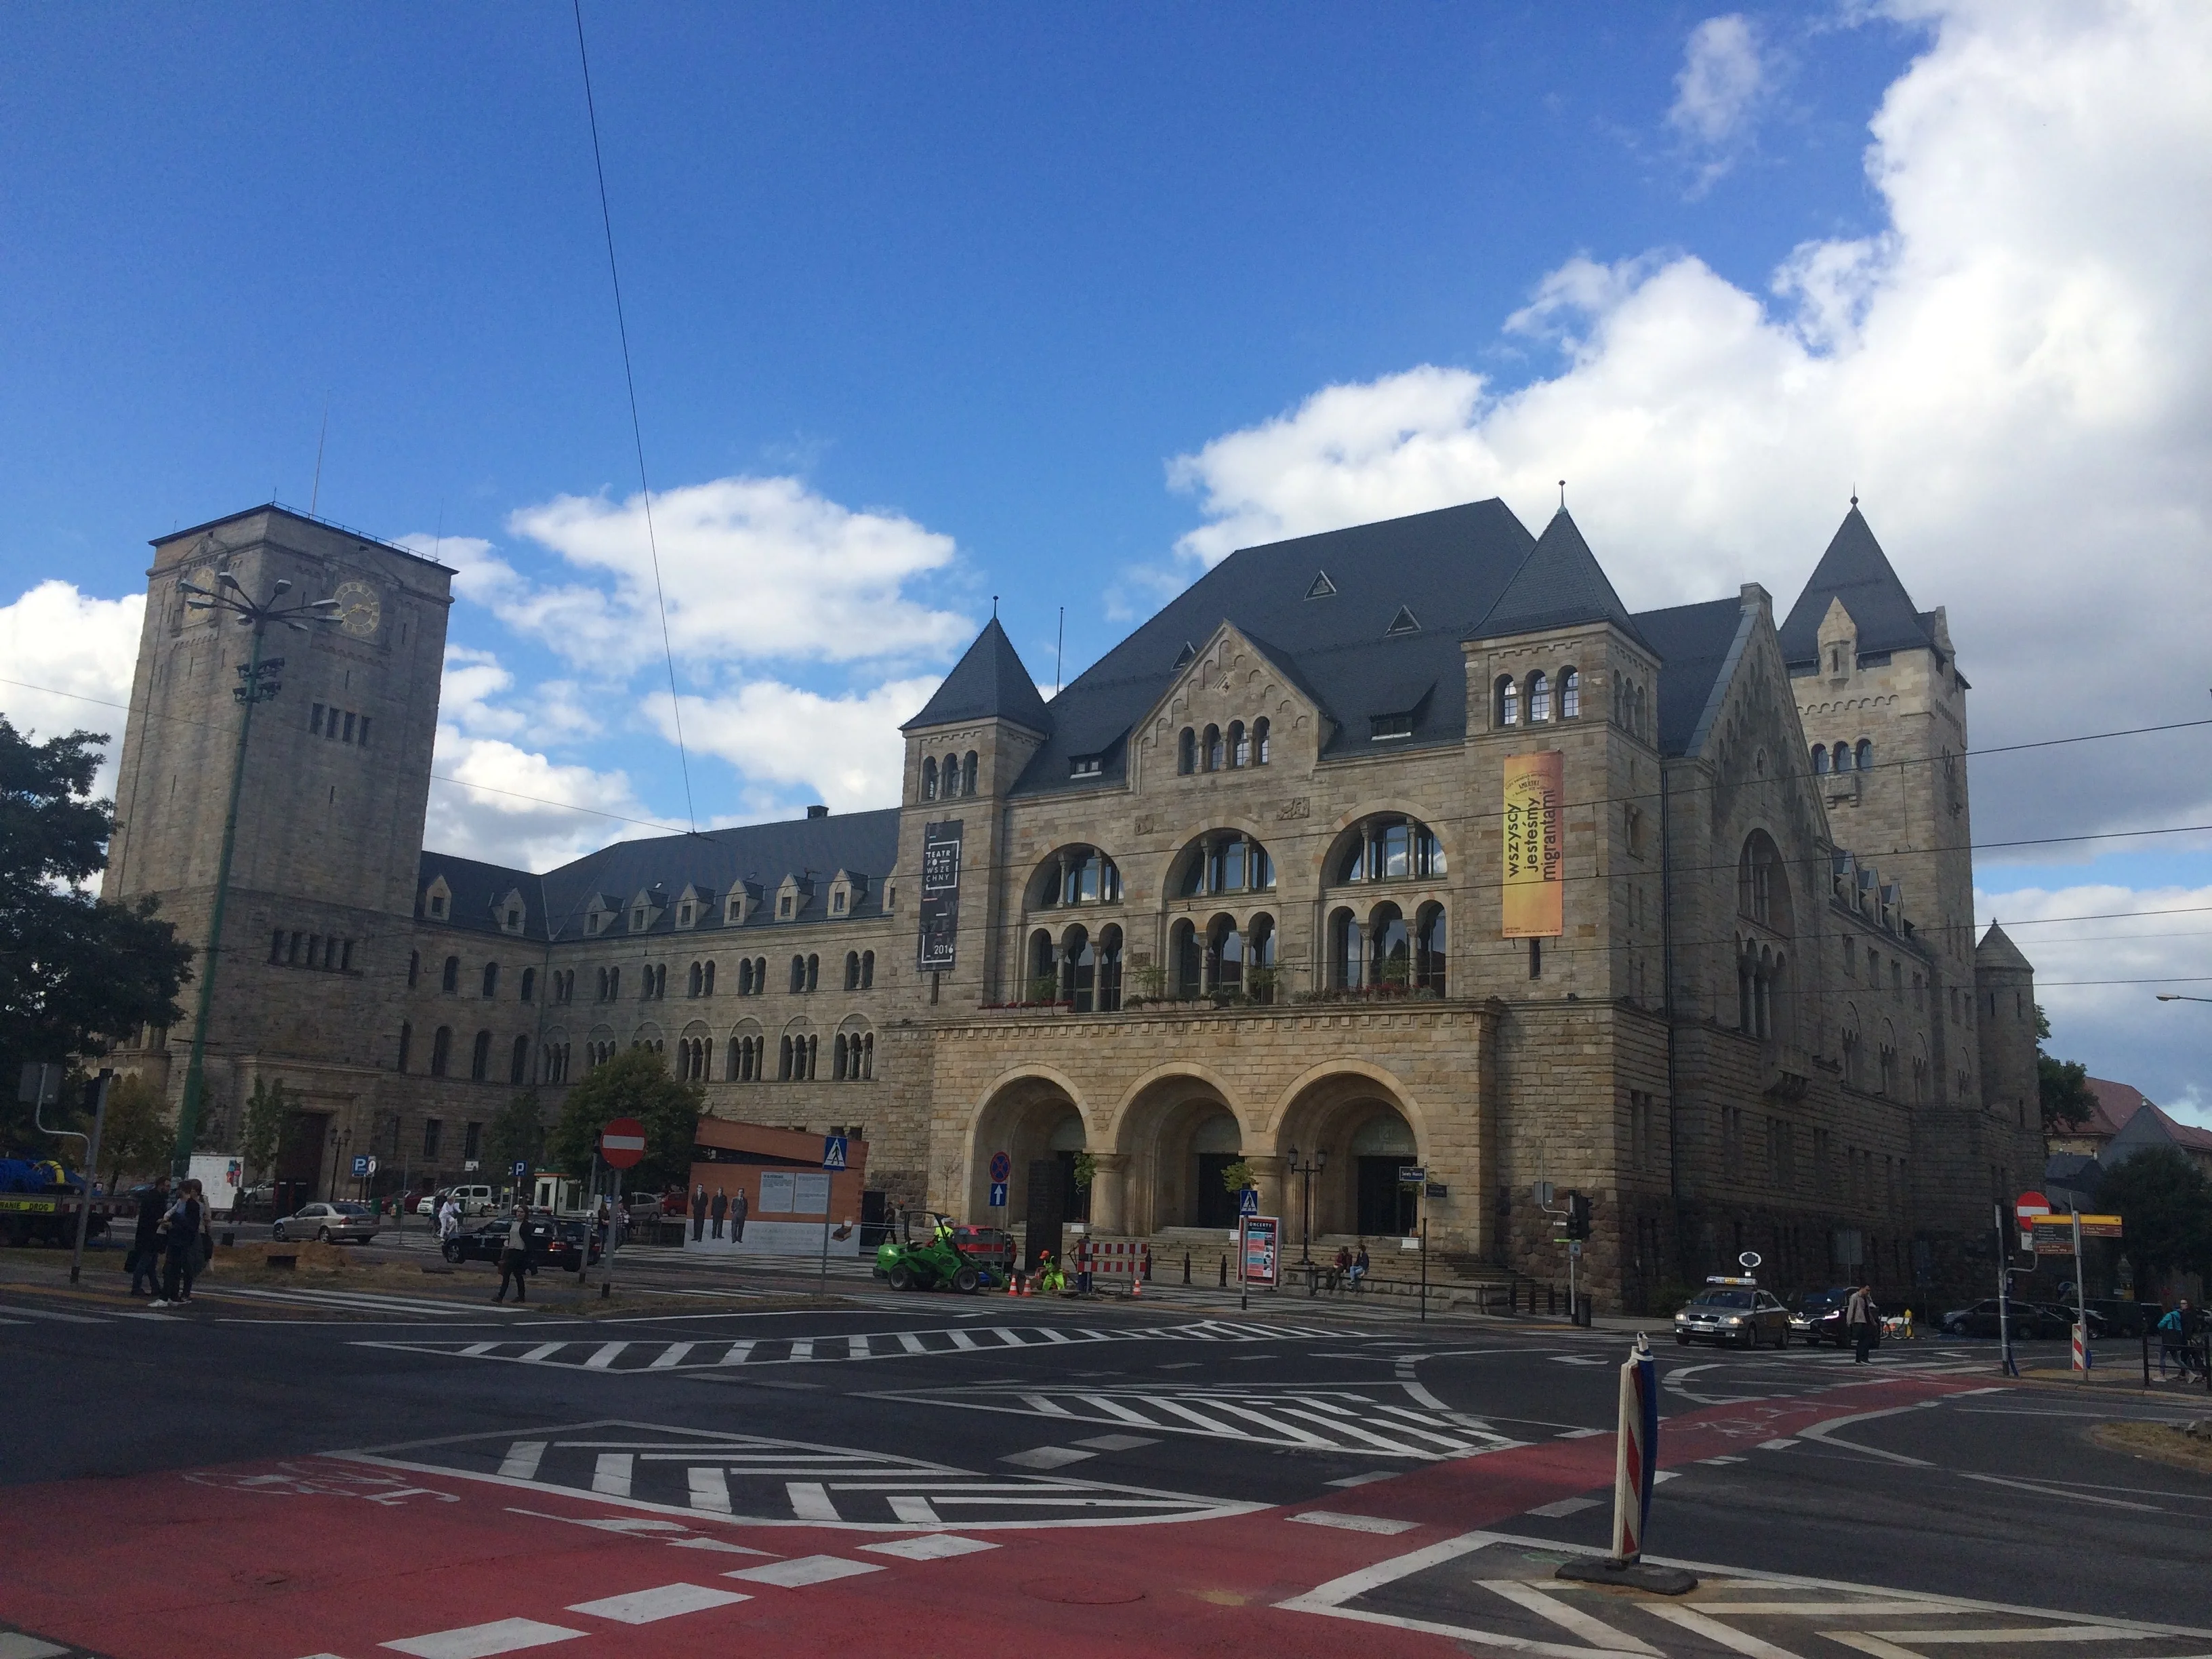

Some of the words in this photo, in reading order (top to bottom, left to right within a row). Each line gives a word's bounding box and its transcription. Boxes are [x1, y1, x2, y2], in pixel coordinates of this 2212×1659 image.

[1508, 803, 1521, 878] wszyscy
[1523, 797, 1540, 873] jesteśmy
[1540, 789, 1560, 881] migrantami
[926, 850, 951, 859] TEATR
[926, 865, 950, 874] WSZE
[926, 874, 949, 882] CHNY
[934, 944, 954, 955] 2016
[516, 1162, 525, 1175] P
[29, 1203, 49, 1211] DROG
